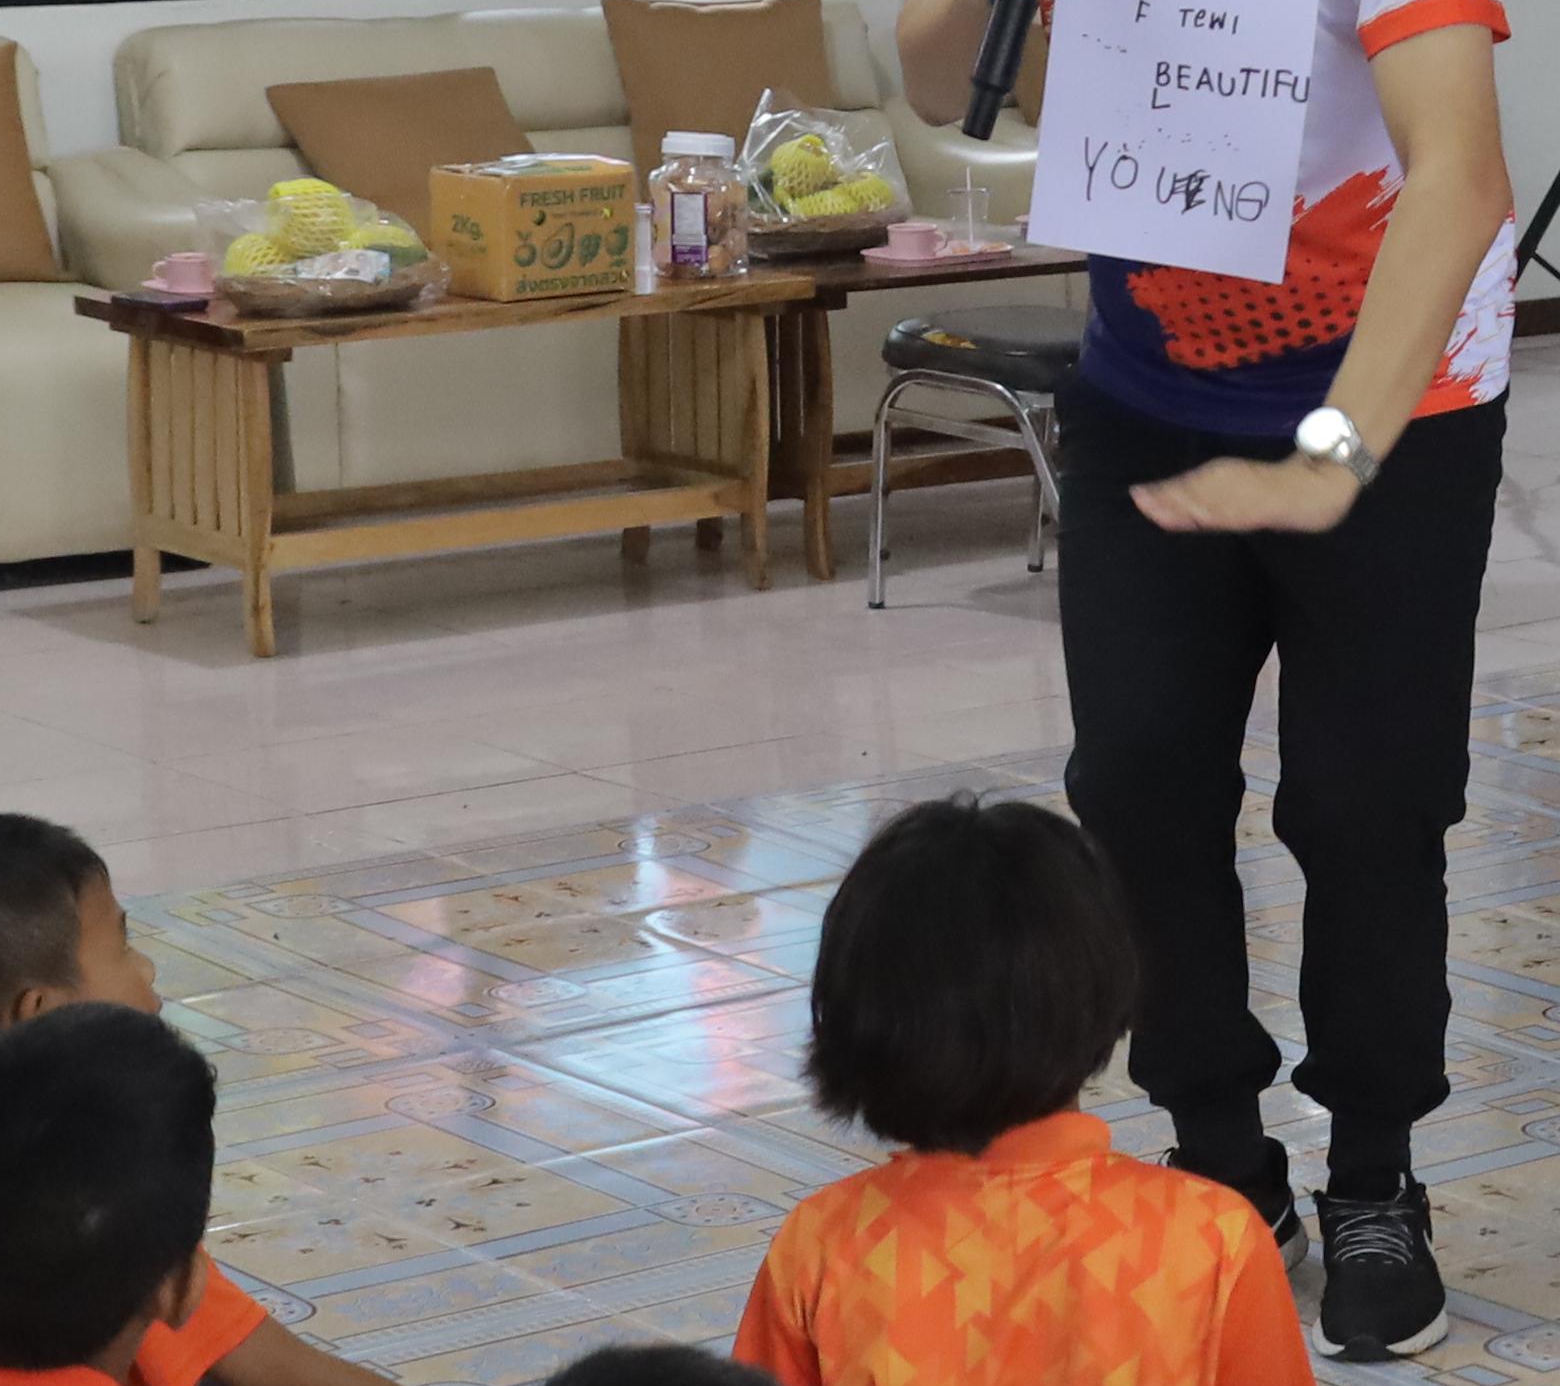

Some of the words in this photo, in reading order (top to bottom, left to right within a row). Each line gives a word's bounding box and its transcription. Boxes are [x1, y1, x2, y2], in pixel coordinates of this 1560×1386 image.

[1155, 61, 1310, 103] BEAUTIFU
[519, 189, 575, 208] FRESH
[578, 183, 627, 203] FRUIT
